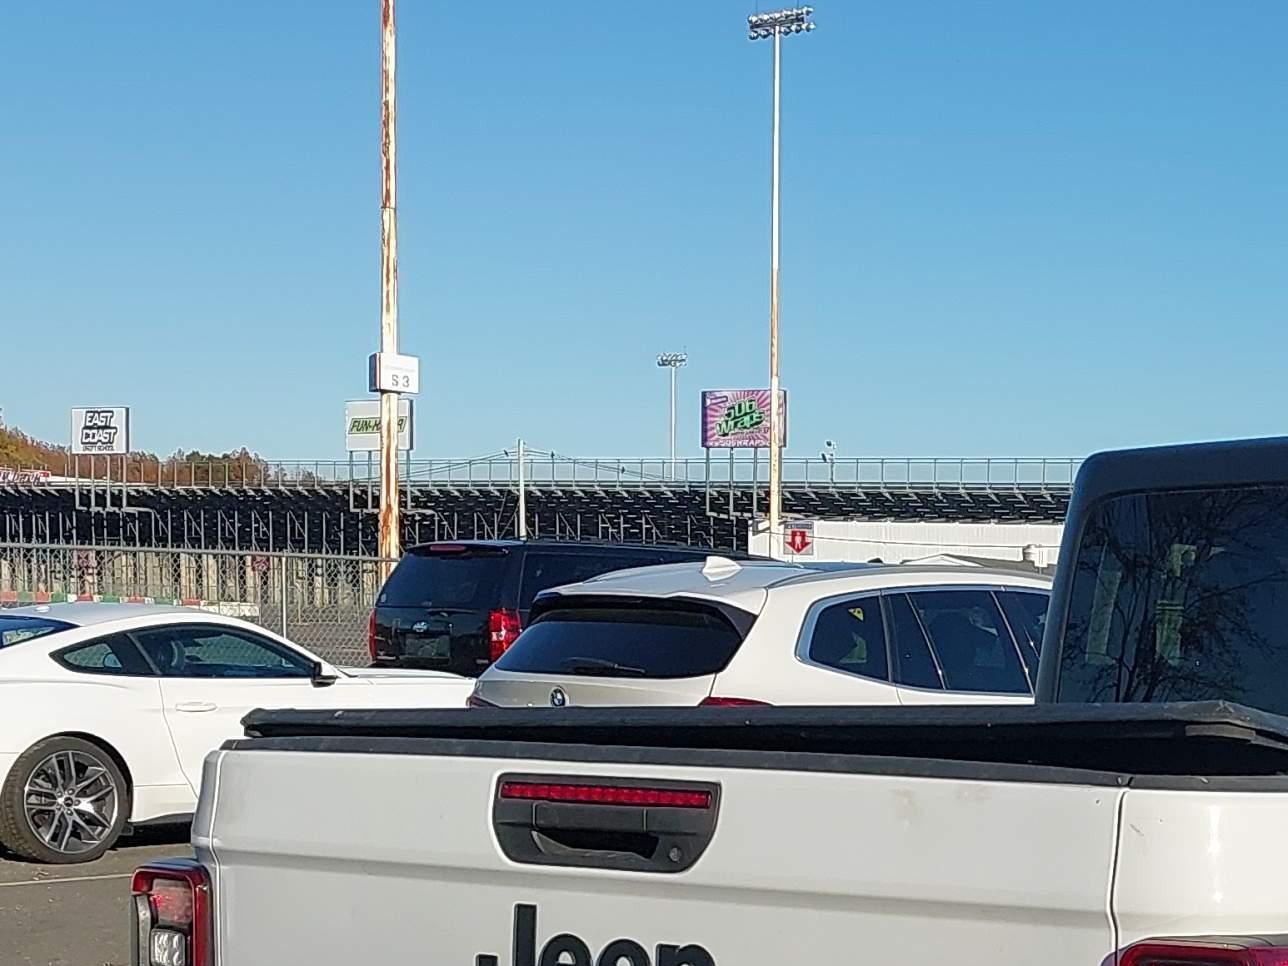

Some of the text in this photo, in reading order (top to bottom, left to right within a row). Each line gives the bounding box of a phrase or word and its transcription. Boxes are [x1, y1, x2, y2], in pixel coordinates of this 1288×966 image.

[391, 374, 410, 388] S 3
[85, 411, 113, 427] EAST
[81, 427, 117, 444] COAST
